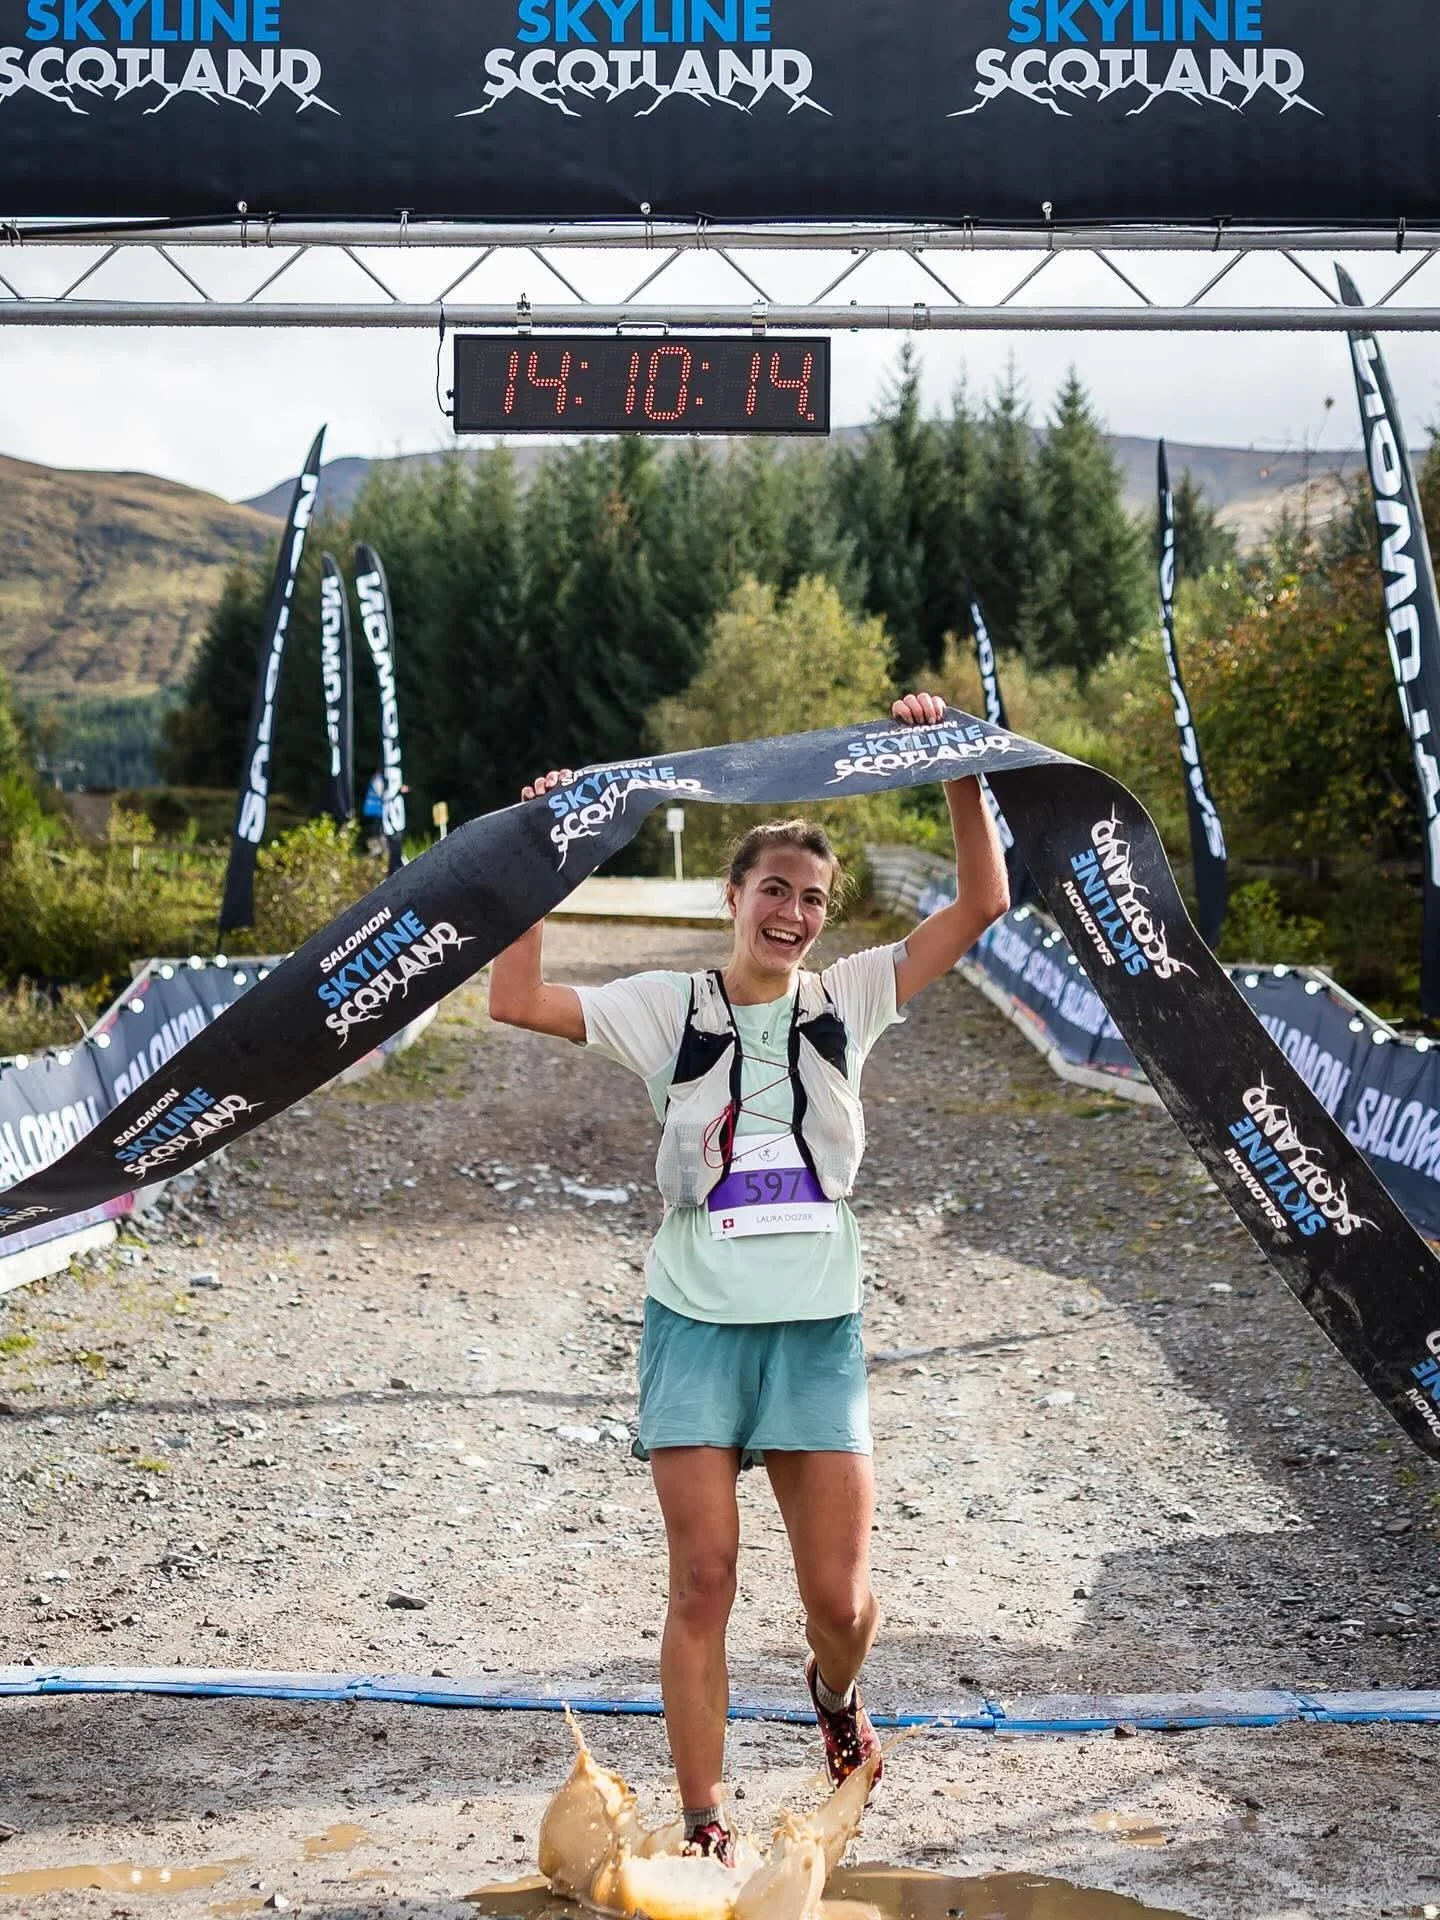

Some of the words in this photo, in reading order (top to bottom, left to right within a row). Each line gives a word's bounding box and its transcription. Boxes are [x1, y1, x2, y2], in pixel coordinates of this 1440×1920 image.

[25, 0, 281, 42] SKYLINE
[517, 0, 772, 43] SKYLINE
[1008, 0, 1262, 42] SKYLINE
[0, 46, 330, 108] SCOTLAND
[470, 48, 822, 110] SCOTLAND
[961, 48, 1314, 110] SCOTLAND
[829, 735, 1016, 780] SCOTLAND
[847, 724, 984, 758] SKYLINE
[548, 767, 676, 818] SKYLINE
[550, 778, 708, 862] SCOTLAND
[1062, 880, 1115, 967] SALOMON
[1070, 848, 1149, 977] SKYLINE
[1091, 808, 1190, 979] SCOTLAND
[317, 910, 427, 1009] SKYLINE
[320, 907, 392, 973] SALOMON
[325, 922, 468, 1043] SCOTLAND
[113, 1088, 181, 1146] SALOMON
[114, 1087, 216, 1164] SKYLINE
[124, 1095, 258, 1180] SCOTLAND
[744, 1169, 802, 1204] 597
[1224, 1148, 1287, 1231] SALOMON
[1228, 1116, 1329, 1237] SKYLINE
[1242, 1077, 1374, 1237] SCOTLAND
